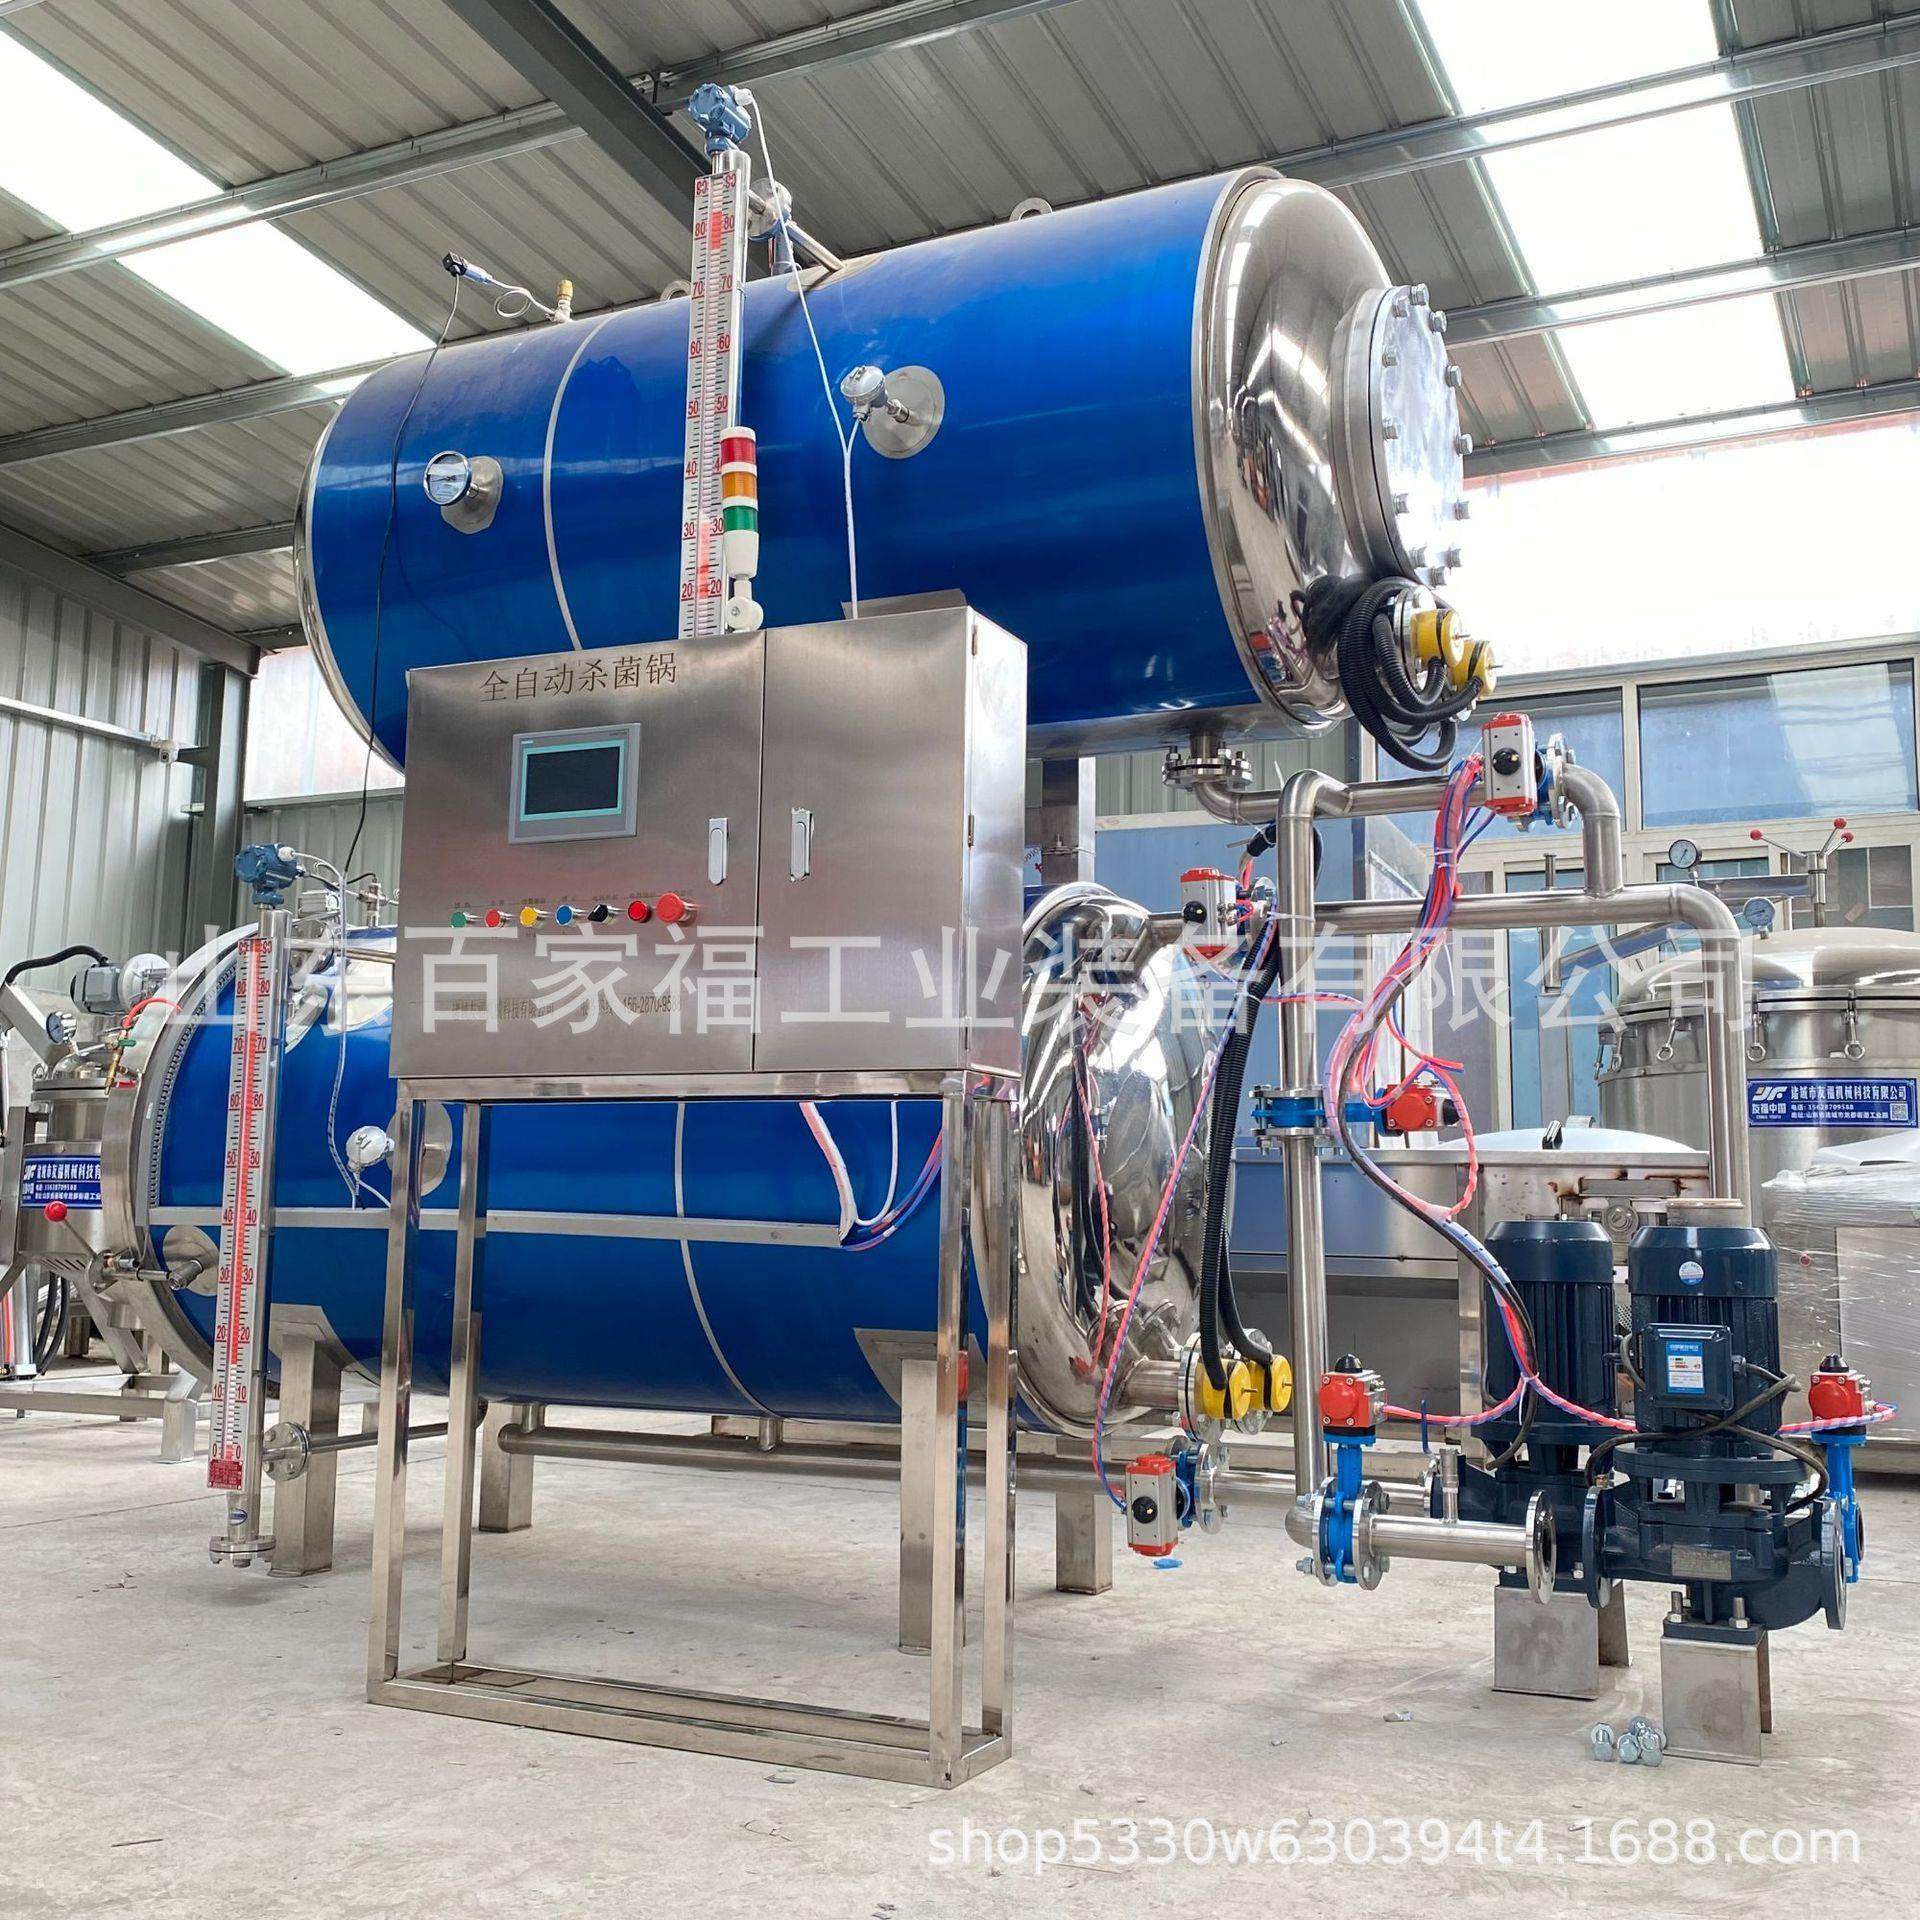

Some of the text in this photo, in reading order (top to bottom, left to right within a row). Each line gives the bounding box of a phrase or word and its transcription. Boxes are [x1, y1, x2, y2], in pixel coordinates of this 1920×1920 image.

[695, 215, 735, 236] 80 80
[693, 275, 732, 296] 70 70
[690, 335, 730, 355] 60 60
[688, 395, 728, 415] 50 50
[685, 457, 722, 475] 40 4
[683, 518, 724, 537] 30 30
[682, 580, 721, 597] 20 20
[480, 652, 677, 702] 全自动杀菌锅
[236, 980, 270, 994] 80 80
[233, 1036, 267, 1050] 70 70
[230, 1094, 264, 1107] 60 60
[226, 1151, 260, 1165] 50 50
[223, 1208, 257, 1222] 40 40
[219, 1267, 253, 1282] 30 30
[216, 1325, 250, 1340] 20 20
[213, 1384, 247, 1399] 10 10
